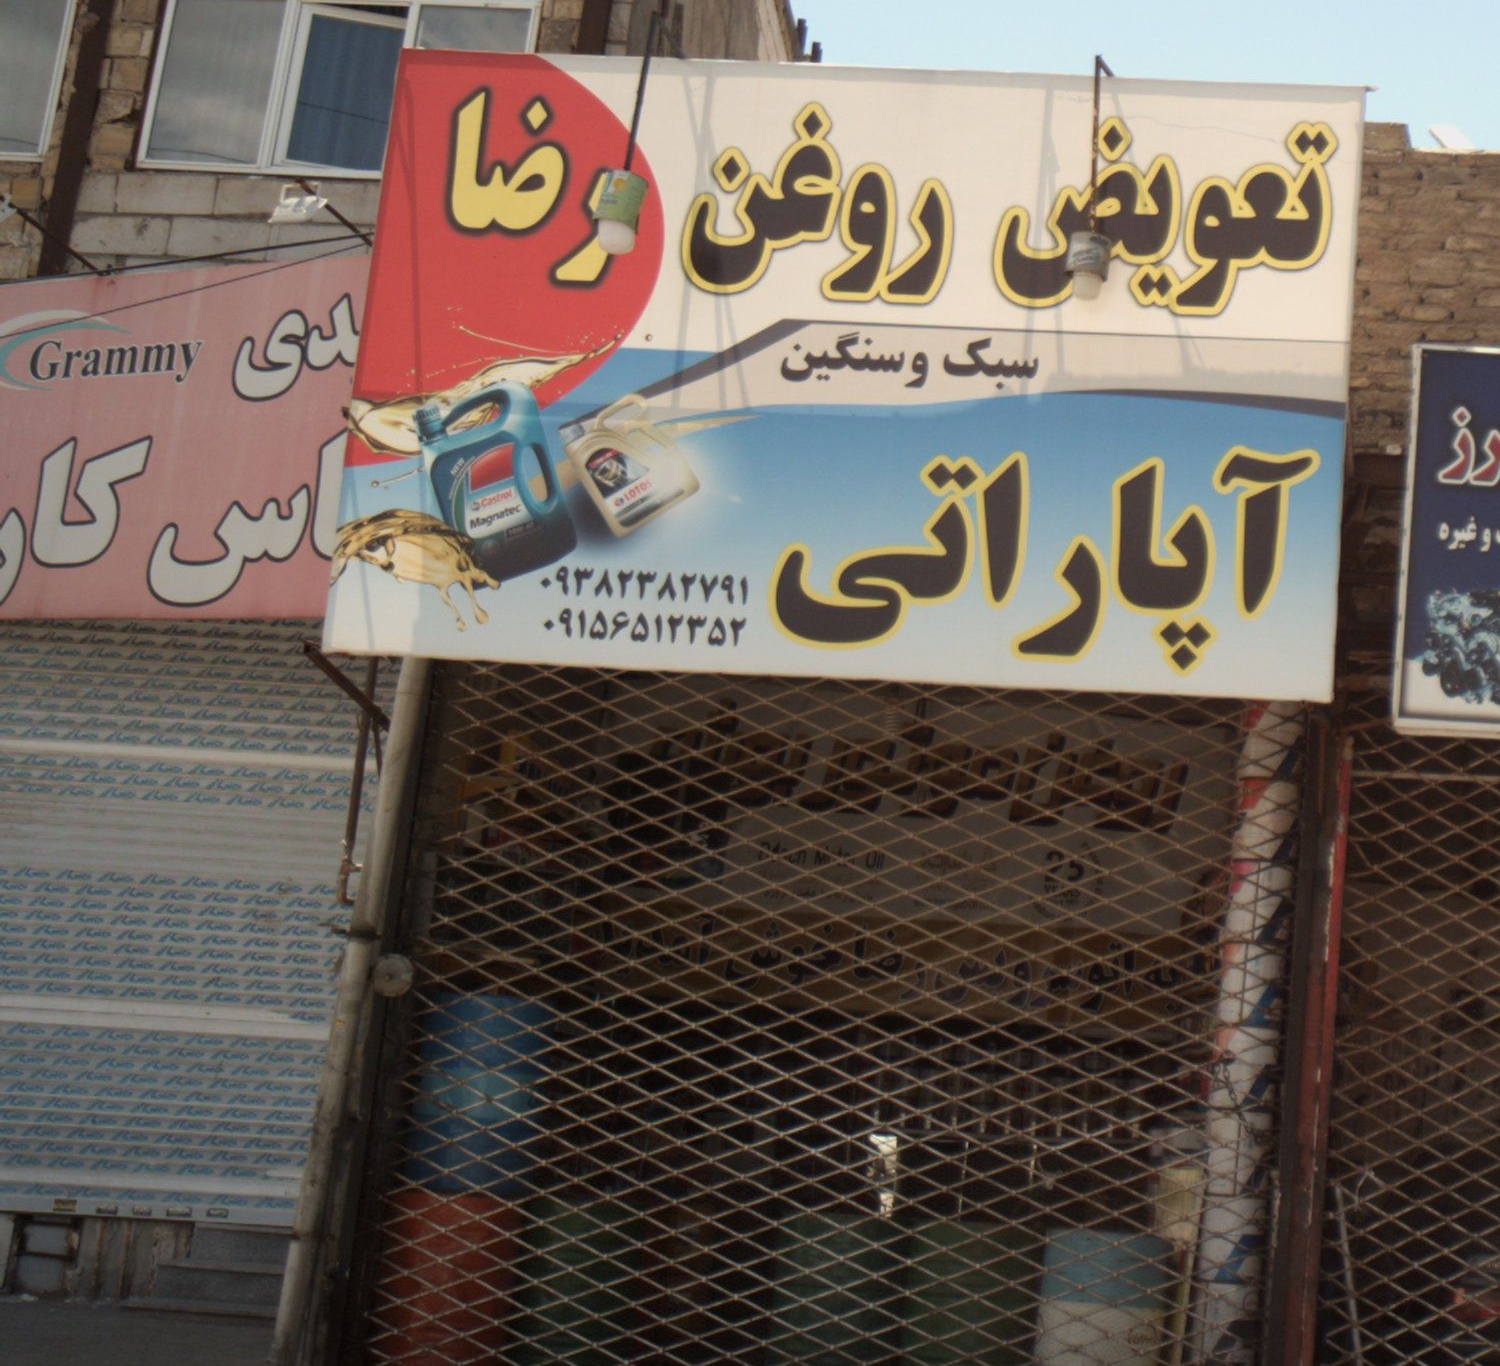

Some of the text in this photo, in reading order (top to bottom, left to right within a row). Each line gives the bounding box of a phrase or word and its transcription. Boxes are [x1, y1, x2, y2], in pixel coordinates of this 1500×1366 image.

[682, 102, 953, 304] روغن
[994, 116, 1337, 316] تعویض
[29, 339, 203, 383] Grammy
[943, 338, 1040, 389] سبک
[469, 504, 523, 530] Magnatec
[480, 489, 513, 509] Castrol
[769, 446, 1320, 674] آپاراتی
[540, 565, 749, 606] ۰۹۳۸۲۳۸۲۷۹۱
[543, 607, 748, 647] ۰۹۱۵۶۵۱۲۳۵۲
